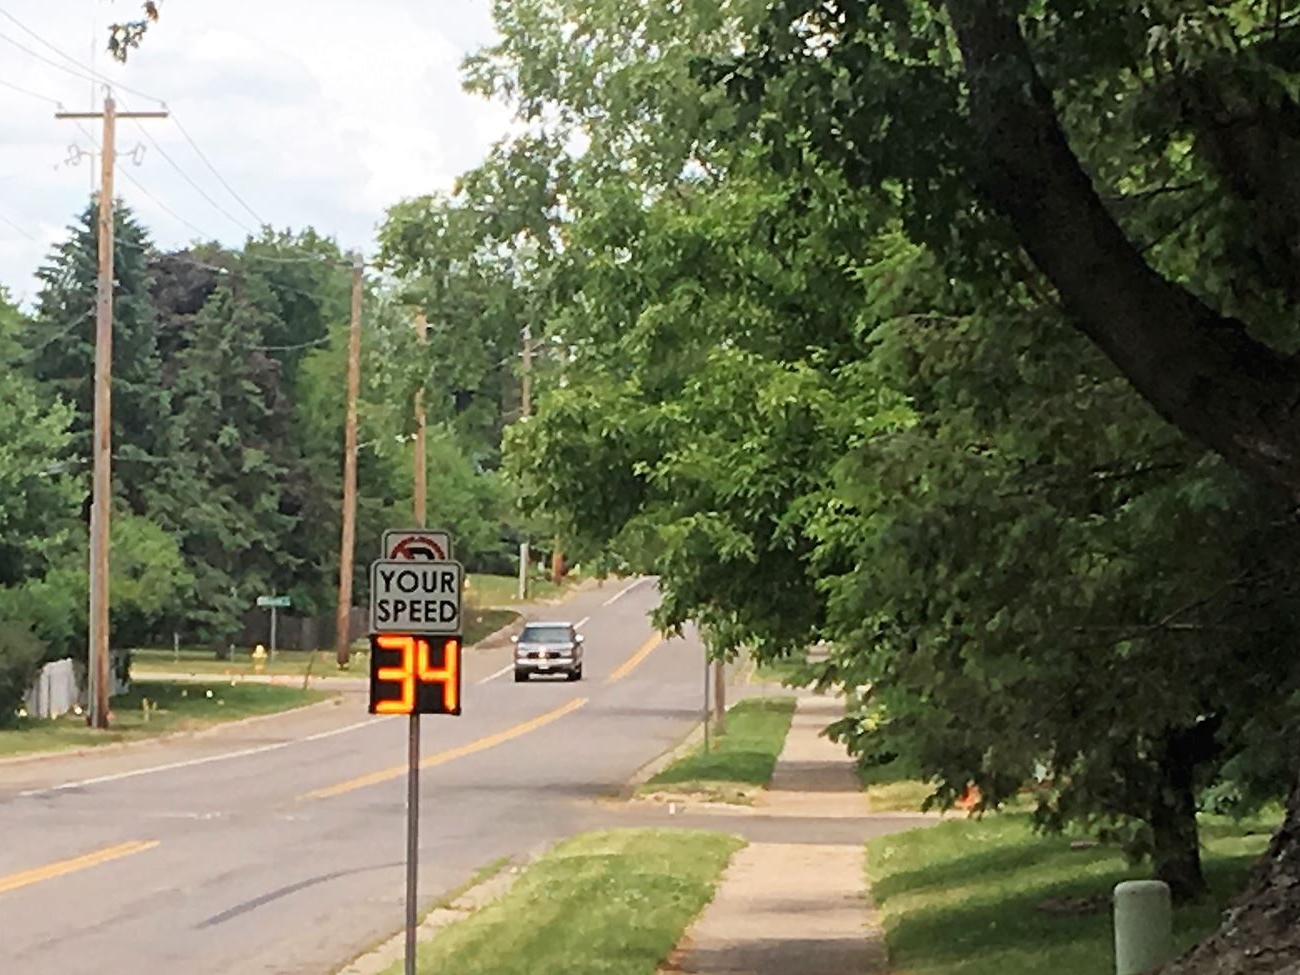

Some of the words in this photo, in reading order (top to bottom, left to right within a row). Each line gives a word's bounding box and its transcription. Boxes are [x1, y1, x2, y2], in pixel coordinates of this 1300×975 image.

[379, 570, 455, 593] YOUR
[377, 600, 457, 622] SPEED
[376, 635, 458, 712] 34
